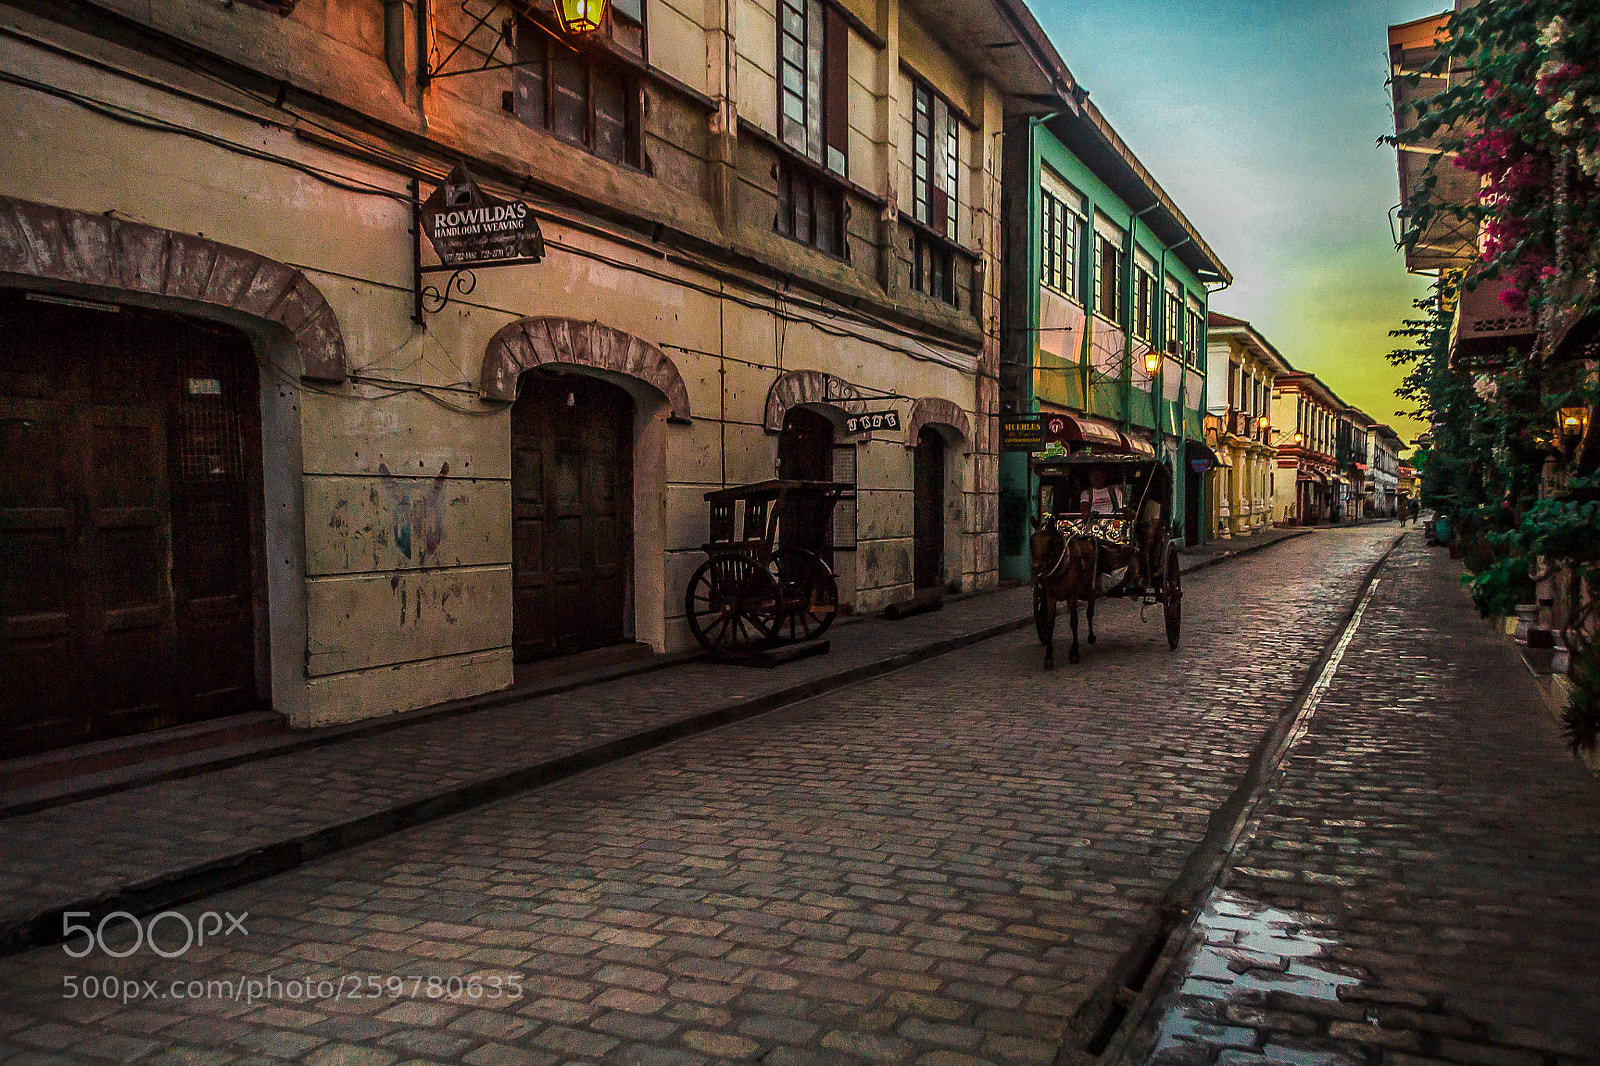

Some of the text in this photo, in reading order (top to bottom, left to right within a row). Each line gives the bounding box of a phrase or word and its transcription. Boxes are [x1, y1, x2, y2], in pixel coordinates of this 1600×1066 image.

[434, 203, 527, 228] ROWILDA'S
[434, 219, 525, 238] HANDLOOM WEAVING
[848, 413, 896, 431] JADE
